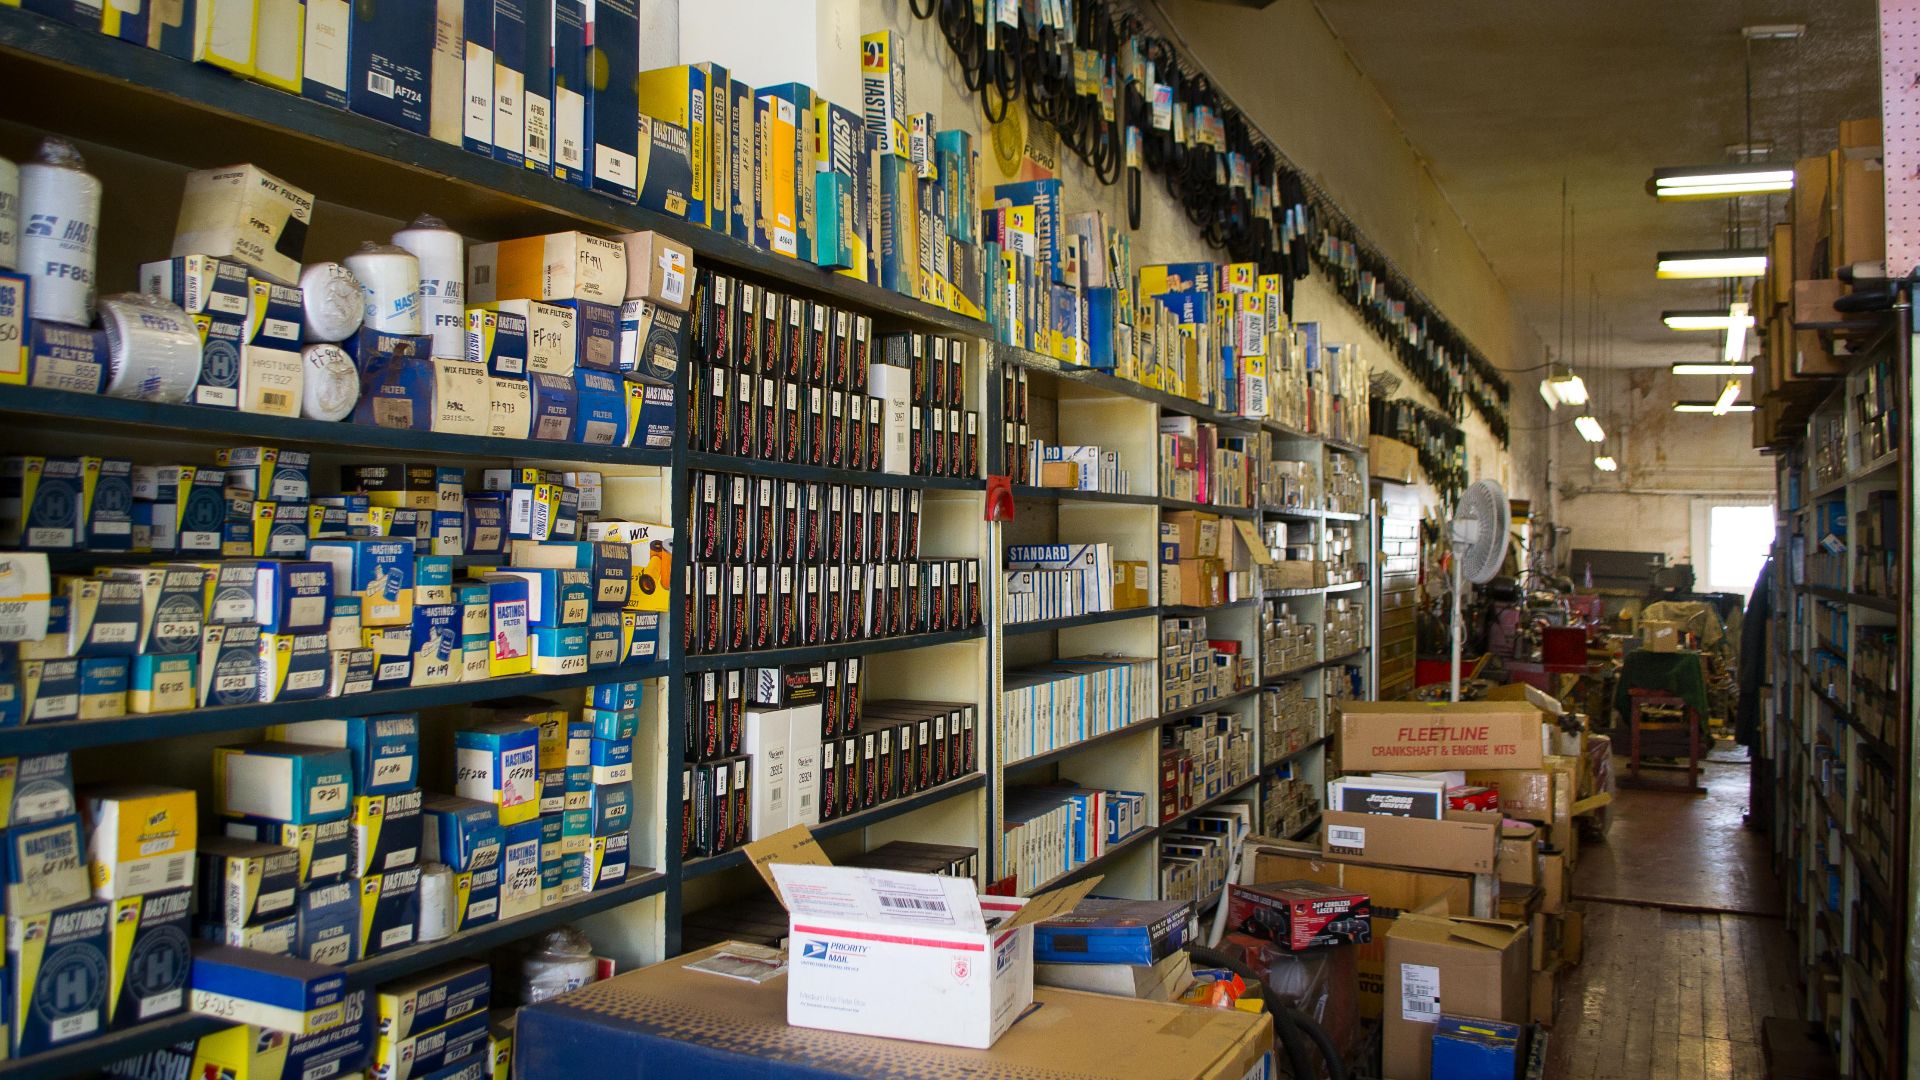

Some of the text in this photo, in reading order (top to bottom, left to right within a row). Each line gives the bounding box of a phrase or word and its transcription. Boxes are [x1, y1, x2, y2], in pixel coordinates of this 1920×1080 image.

[395, 85, 422, 103] AF724
[531, 104, 544, 116] AF805
[716, 93, 724, 125] AF815
[654, 122, 686, 147] HASTINGS
[261, 178, 311, 210] WIX FILTERS
[586, 237, 622, 251] WIX FILTERS
[920, 209, 929, 270] HASTINGS
[934, 215, 945, 275] HASTINGS
[218, 263, 247, 279] HASTINGS
[189, 276, 197, 309] HASTINGS
[271, 285, 302, 303] HASTINGS
[537, 306, 573, 319] WIX FILTERS
[586, 305, 615, 325] HASTINGS
[655, 307, 682, 327] HASTINGS
[210, 321, 240, 336] HASTINGS
[498, 315, 526, 331] HASTINGS
[51, 347, 94, 362] FILTER
[252, 358, 301, 373] HASTINGS
[443, 366, 484, 376] WIX FILTERS
[58, 377, 96, 391] FF855
[380, 385, 406, 395] FILTER
[495, 381, 529, 391] WIX FILTERS
[540, 376, 571, 391] HASTINGS
[584, 373, 616, 392] HASTINGS
[645, 387, 674, 402] HASTINGS
[547, 406, 567, 415] FILTER
[593, 410, 612, 419] FILTER
[535, 502, 547, 539] HASTINGS
[608, 527, 620, 537] WIX
[629, 526, 649, 541] WIX
[372, 544, 402, 556] HASTINGS
[601, 544, 629, 560] HASTINGS
[1010, 546, 1069, 562] STANDARD
[377, 555, 396, 564] FILTER
[220, 564, 255, 582] HASTINGS
[605, 568, 623, 577] FILTER
[165, 573, 203, 588] HASTINGS
[291, 574, 326, 589] HASTINGS
[297, 587, 320, 595] FILTER
[426, 607, 454, 617] HASTINGS
[497, 604, 525, 619] HASTINGS
[431, 616, 450, 625] FILTER
[503, 618, 521, 627] FILTER
[635, 615, 657, 626] HASTINGS
[225, 627, 258, 642] HASTINGS
[294, 635, 327, 649] HASTINGS
[595, 631, 614, 639] FILTER
[44, 661, 77, 675] HASTINGS
[376, 719, 415, 737] HASTINGS
[1398, 727, 1489, 741] FLEETLINE
[1372, 745, 1516, 756] CRANKSHAFT & ENGINE KITS
[22, 753, 67, 772] HASTINGS
[505, 750, 533, 767] HASTINGS
[387, 792, 422, 815] HASTINGS
[149, 810, 168, 825] WIX
[317, 819, 349, 840] HASTINGS
[607, 833, 627, 850] HASTINGS
[508, 847, 536, 862] HASTINGS
[518, 856, 536, 867] FILTER
[383, 869, 420, 893] HASTINGS
[472, 870, 498, 887] HASTINGS
[143, 891, 191, 918] HASTINGS
[232, 883, 241, 928] HASTINGS
[310, 886, 351, 910] HASTINGS
[1326, 900, 1351, 909] CORDLESS
[1316, 905, 1350, 915] LASER DRILL
[52, 907, 107, 936] HASTINGS
[319, 926, 344, 940] FILTER
[831, 942, 867, 953] PRIORITY
[829, 954, 848, 963] MAIL
[146, 950, 173, 988] H
[56, 968, 88, 1009] H
[418, 987, 447, 1008] HASTINGS
[417, 1032, 446, 1055] HASTINGS
[309, 1066, 334, 1080] TF60
